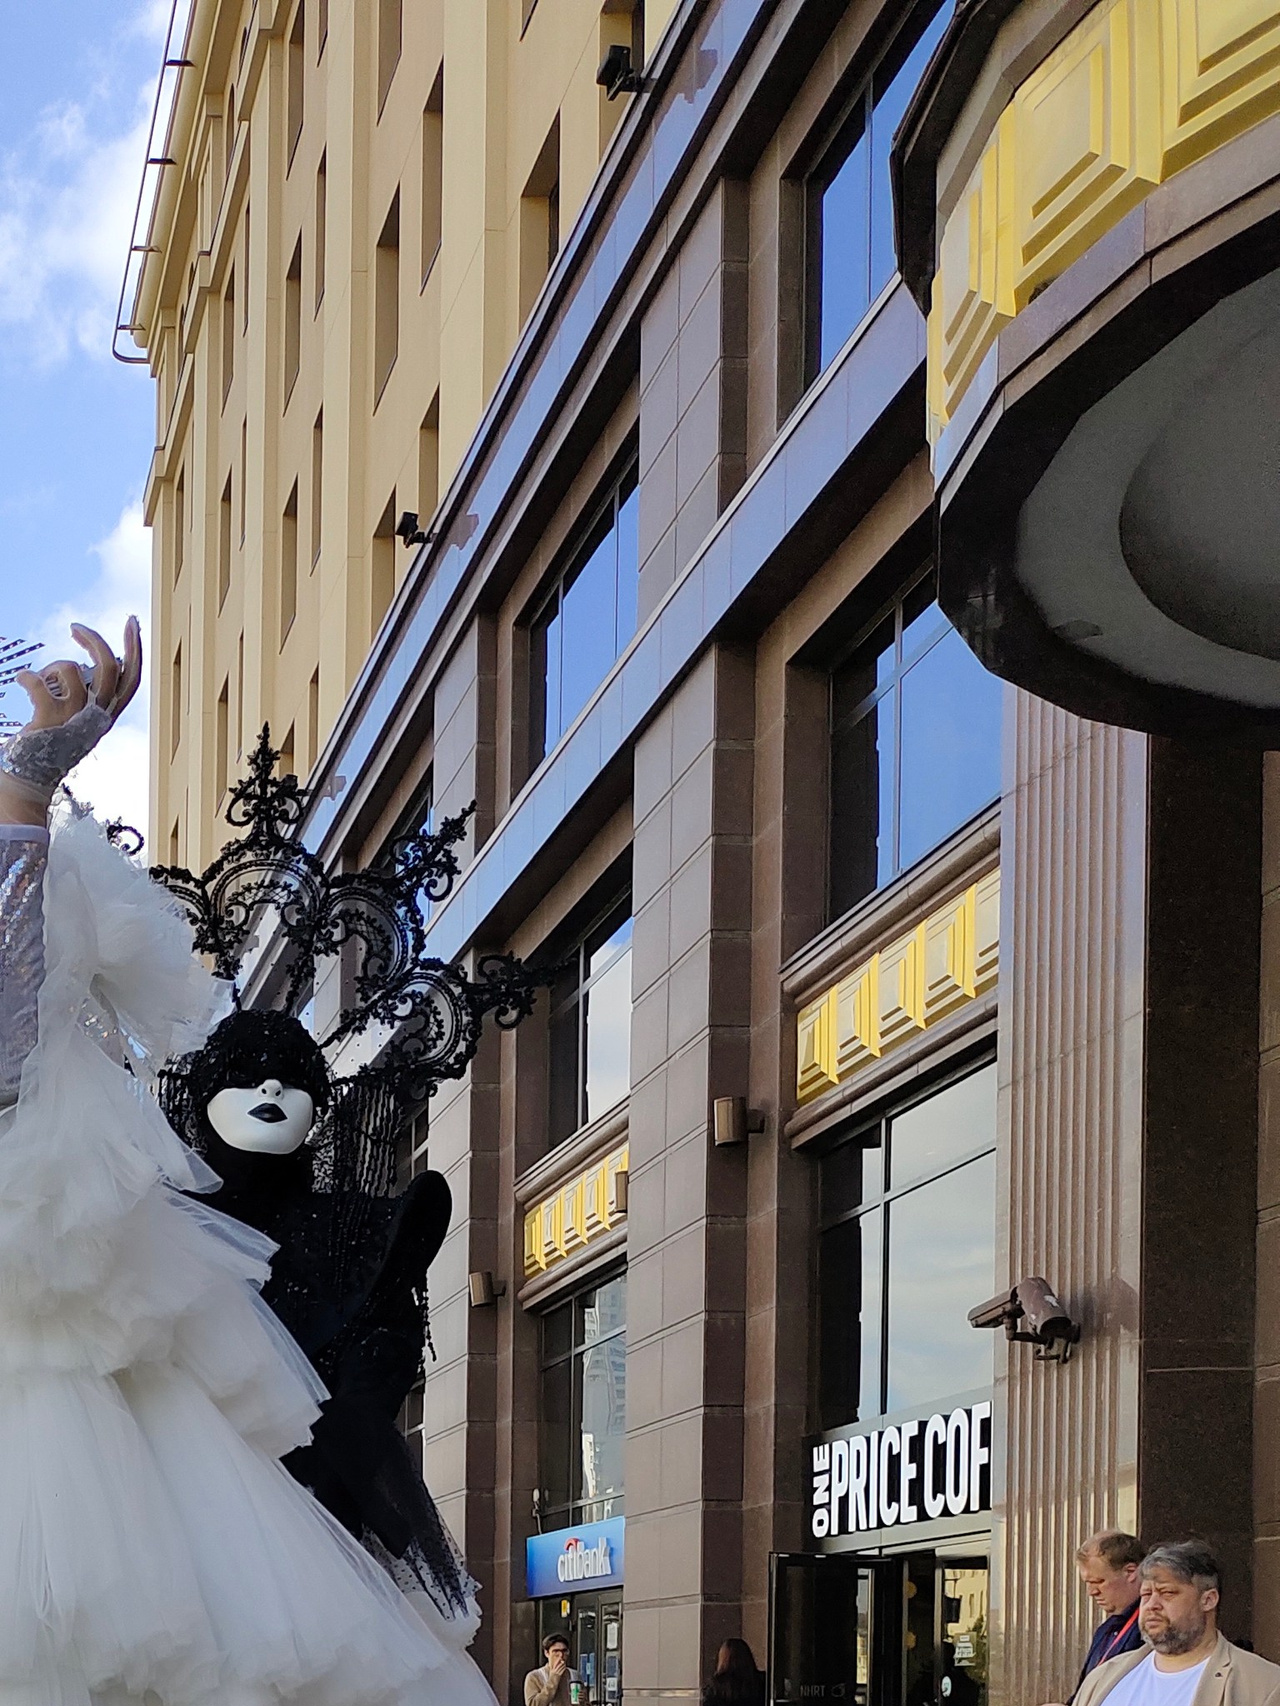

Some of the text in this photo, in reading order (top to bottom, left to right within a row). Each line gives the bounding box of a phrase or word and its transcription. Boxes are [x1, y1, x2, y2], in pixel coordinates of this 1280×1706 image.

[812, 1401, 992, 1538] ONE PRICE COF
[557, 1537, 612, 1583] citibank
